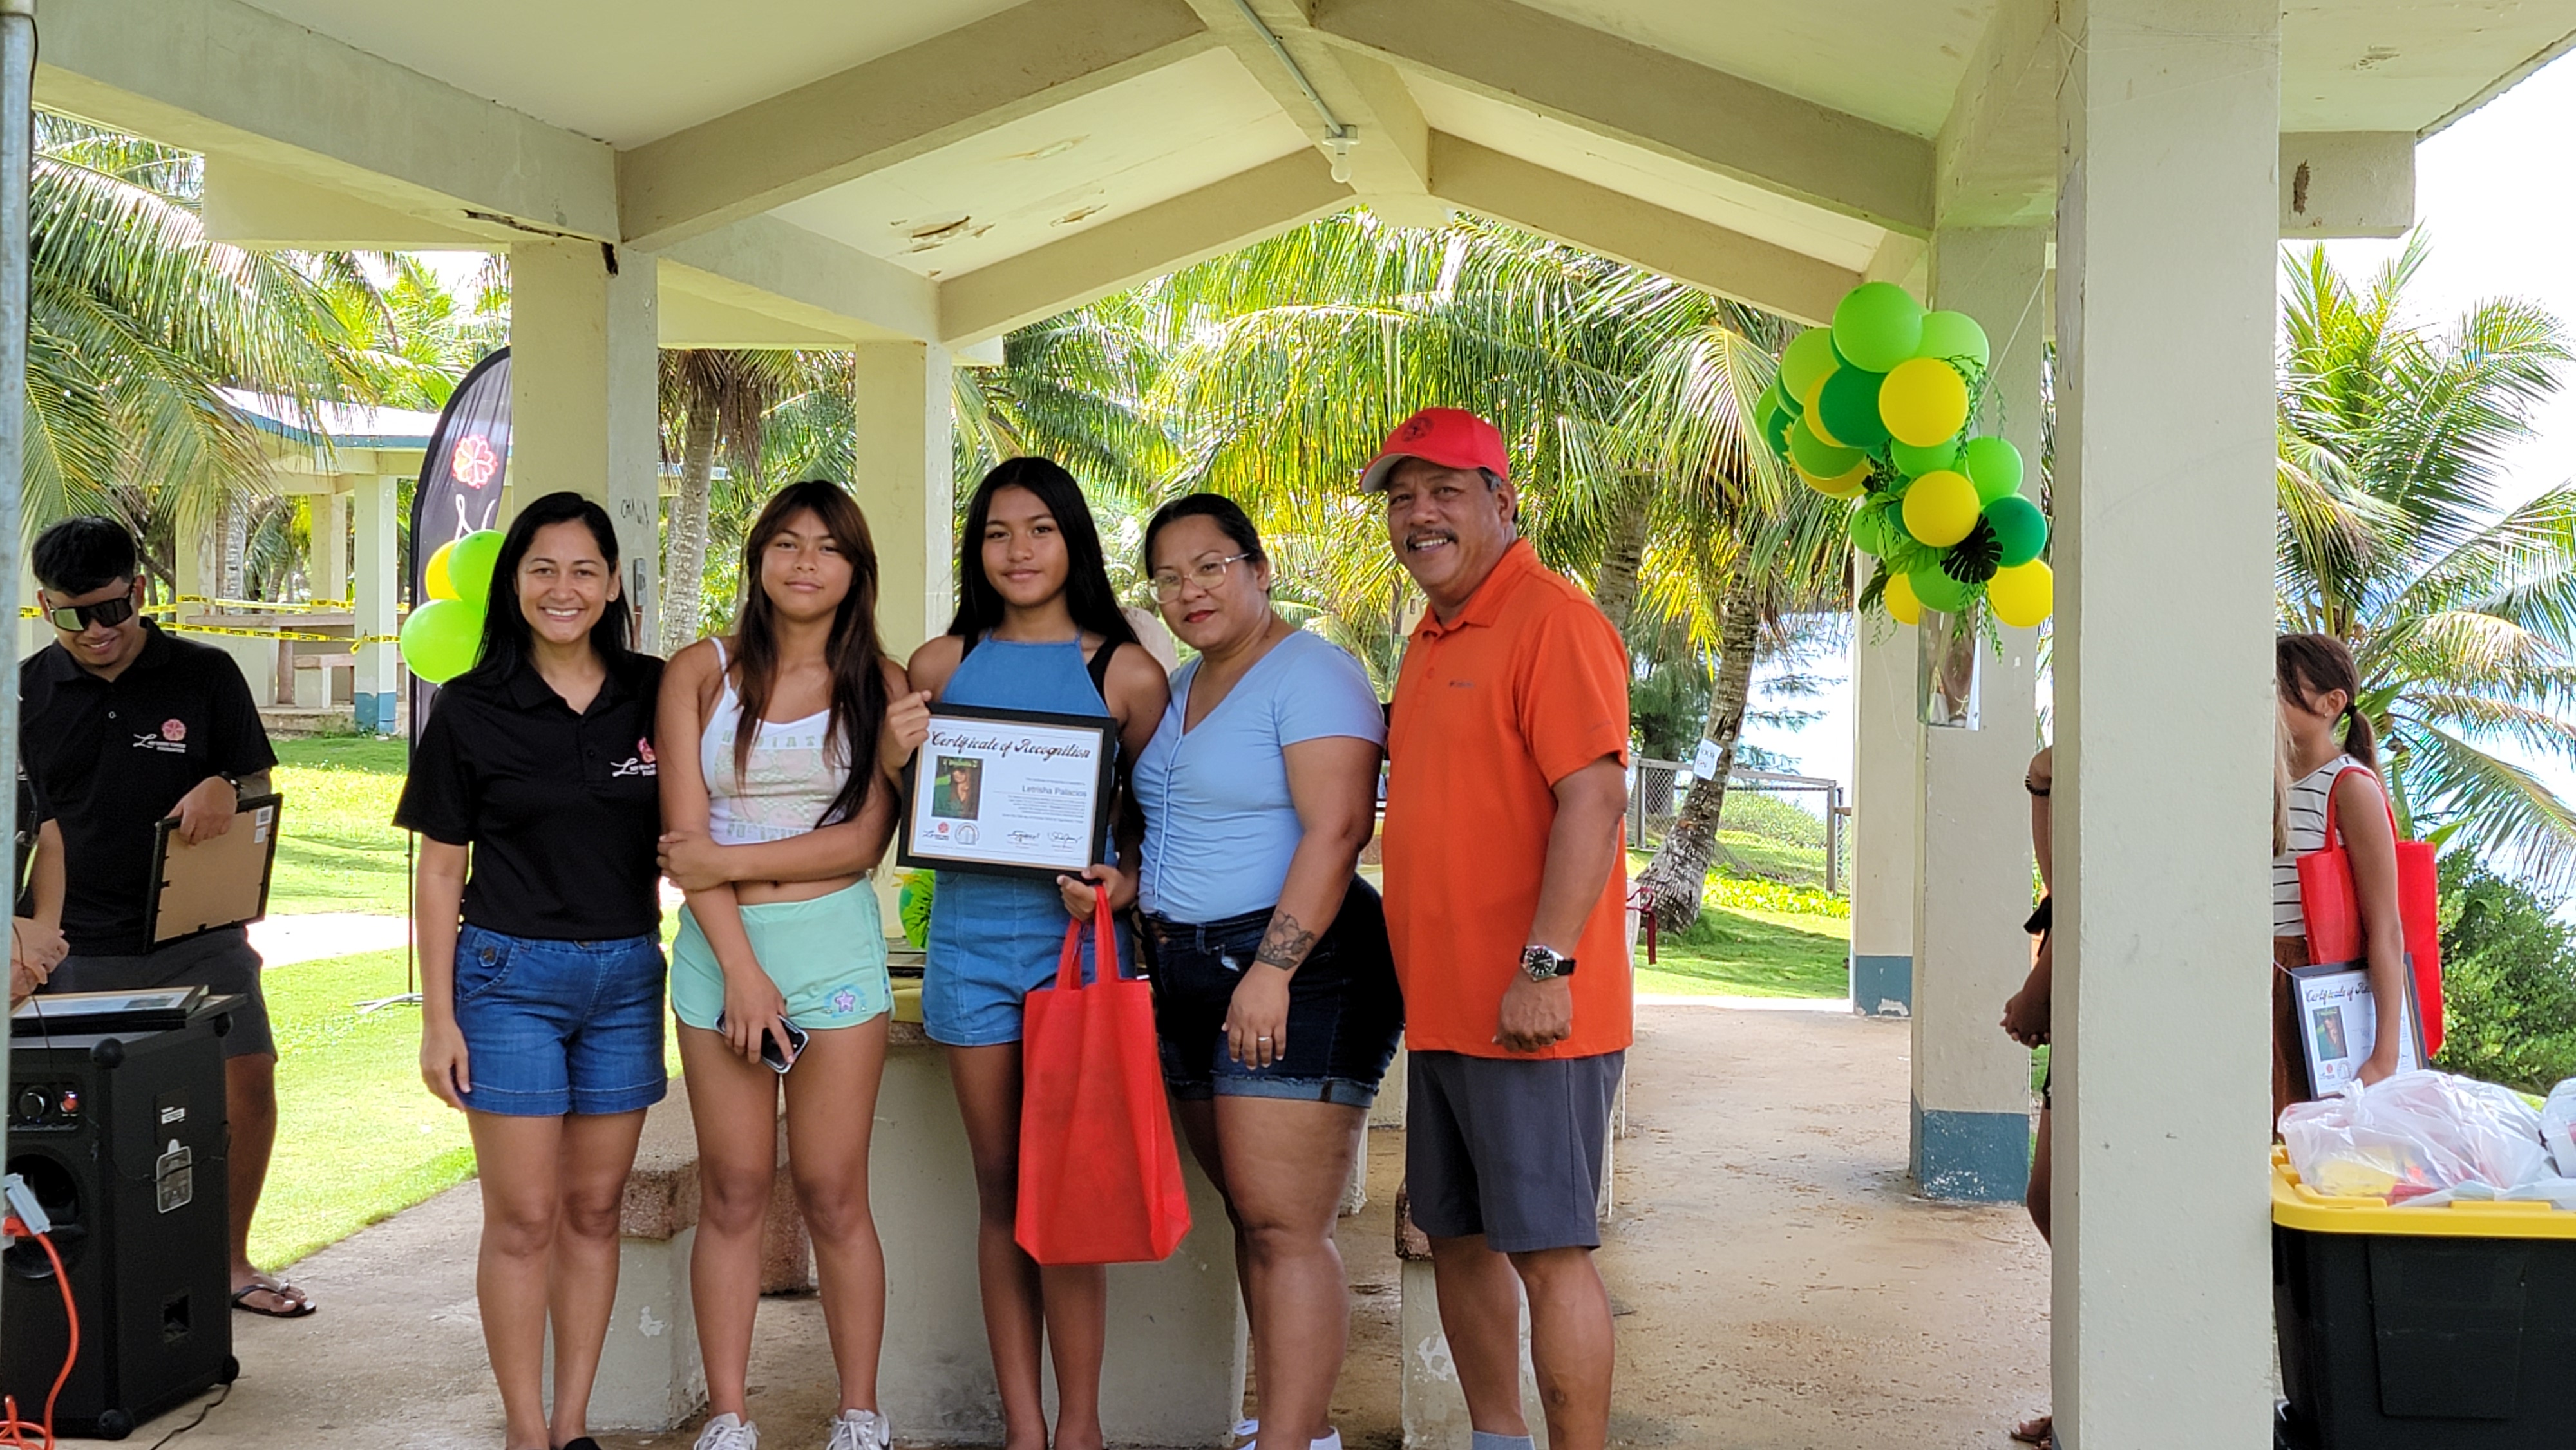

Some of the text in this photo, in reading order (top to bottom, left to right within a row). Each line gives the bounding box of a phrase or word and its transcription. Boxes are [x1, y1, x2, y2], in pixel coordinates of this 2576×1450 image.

[932, 731, 1090, 760] Certificate of Recognition
